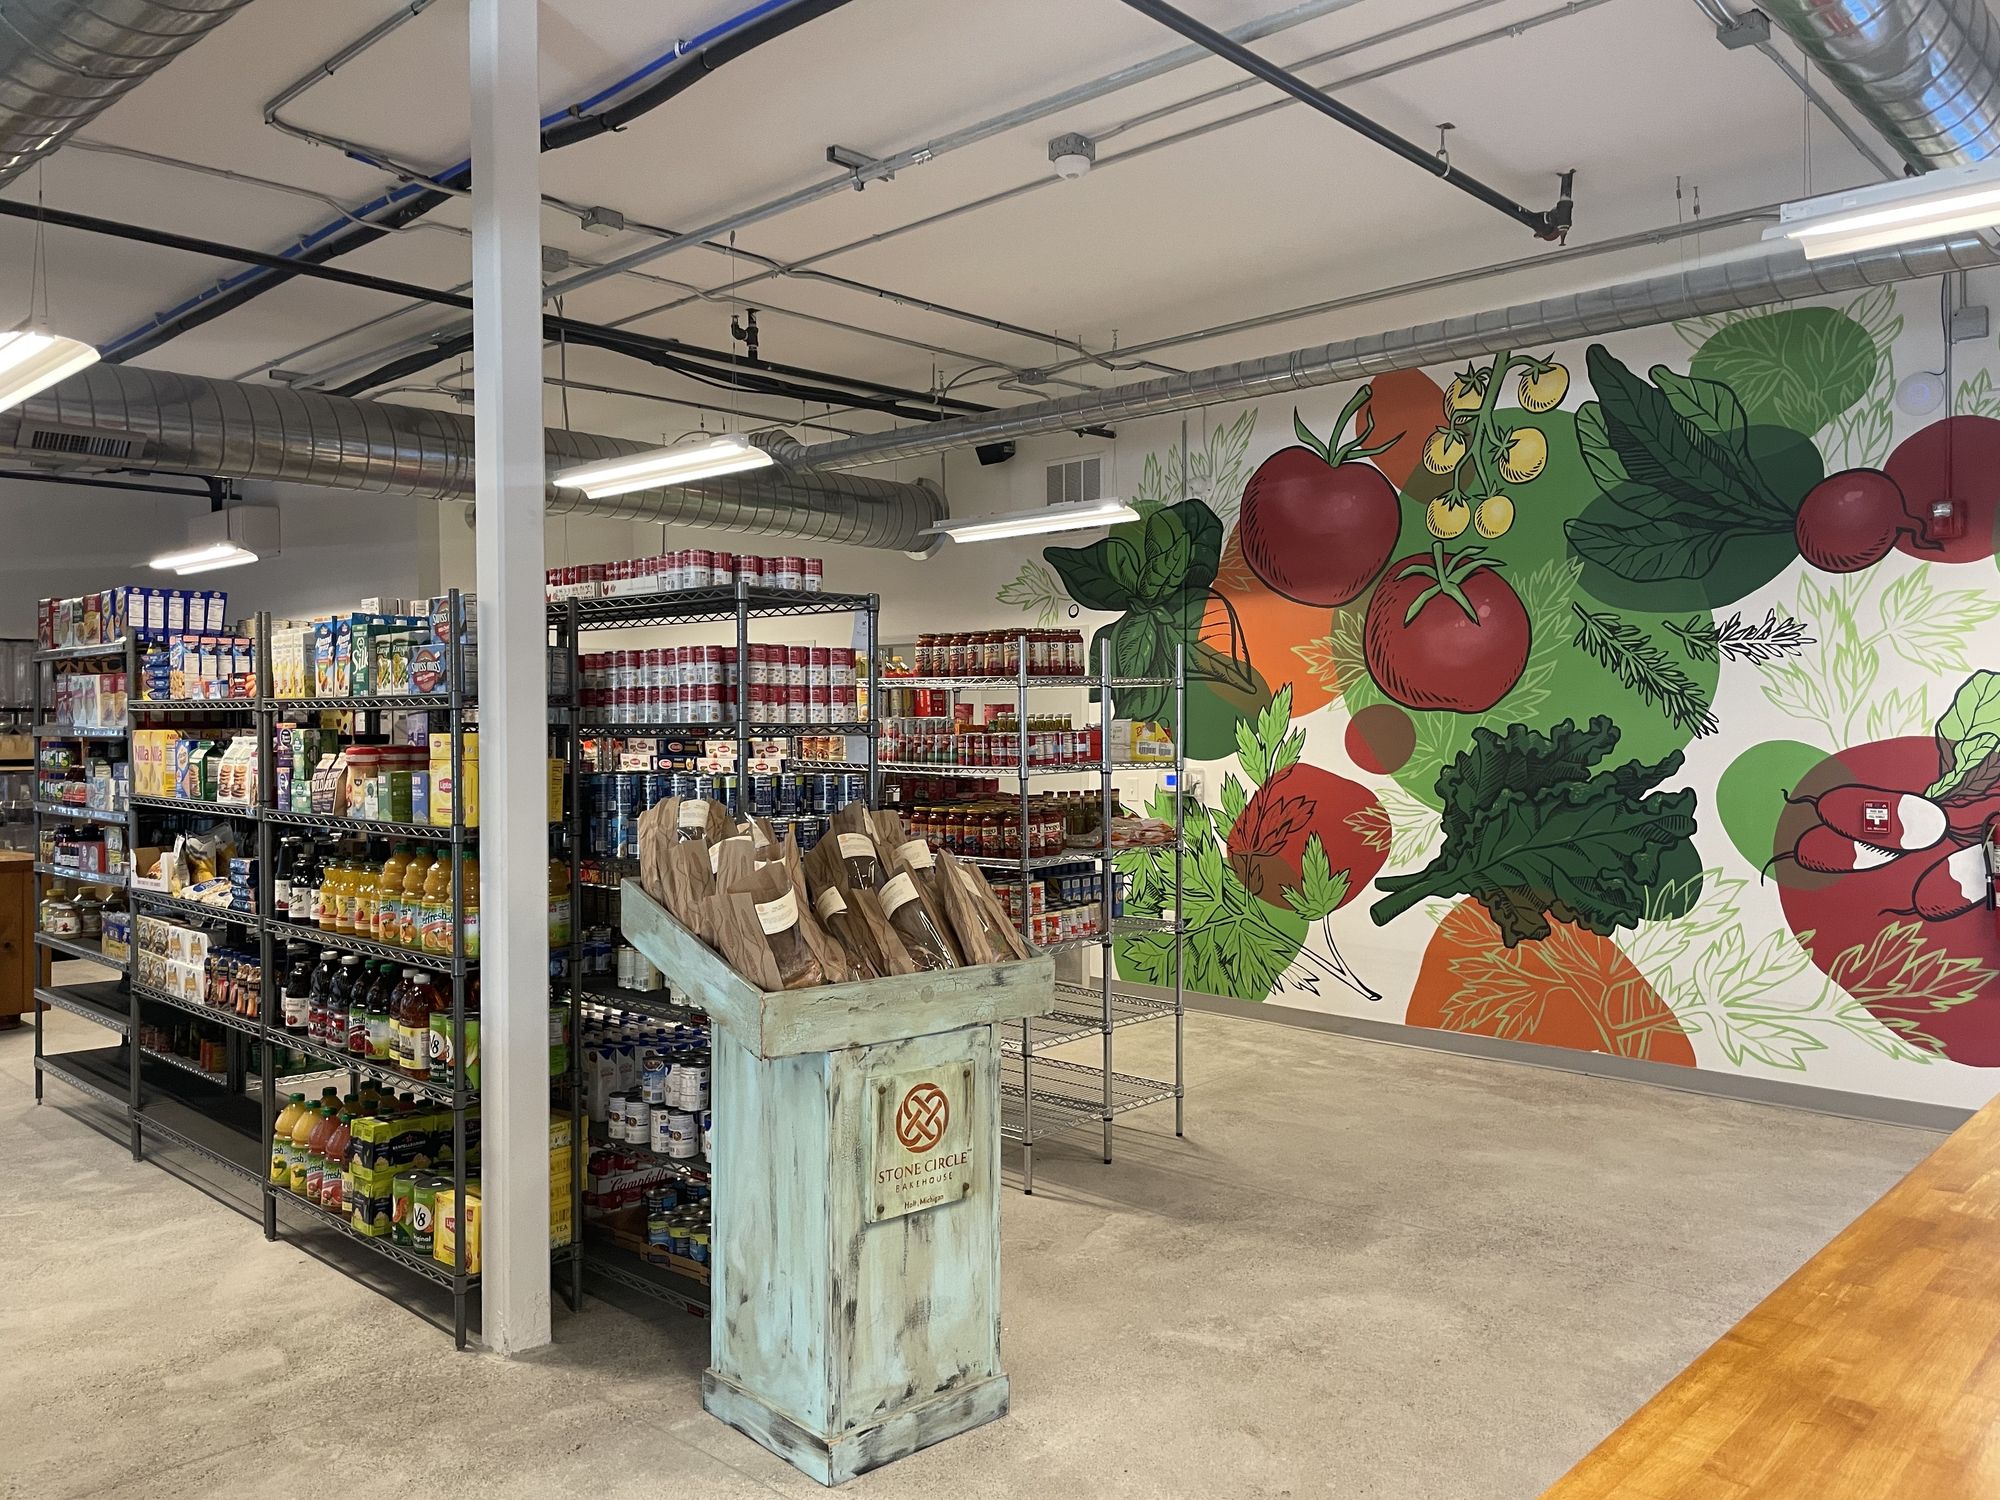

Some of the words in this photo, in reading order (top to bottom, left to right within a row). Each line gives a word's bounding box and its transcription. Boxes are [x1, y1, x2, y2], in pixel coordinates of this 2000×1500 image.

[878, 1163, 921, 1184] STONE
[895, 1171, 953, 1193] BAKEHOUSE
[919, 1194, 944, 1206] Michigan
[414, 1207, 426, 1227] V8
[556, 1224, 568, 1233] TEA
